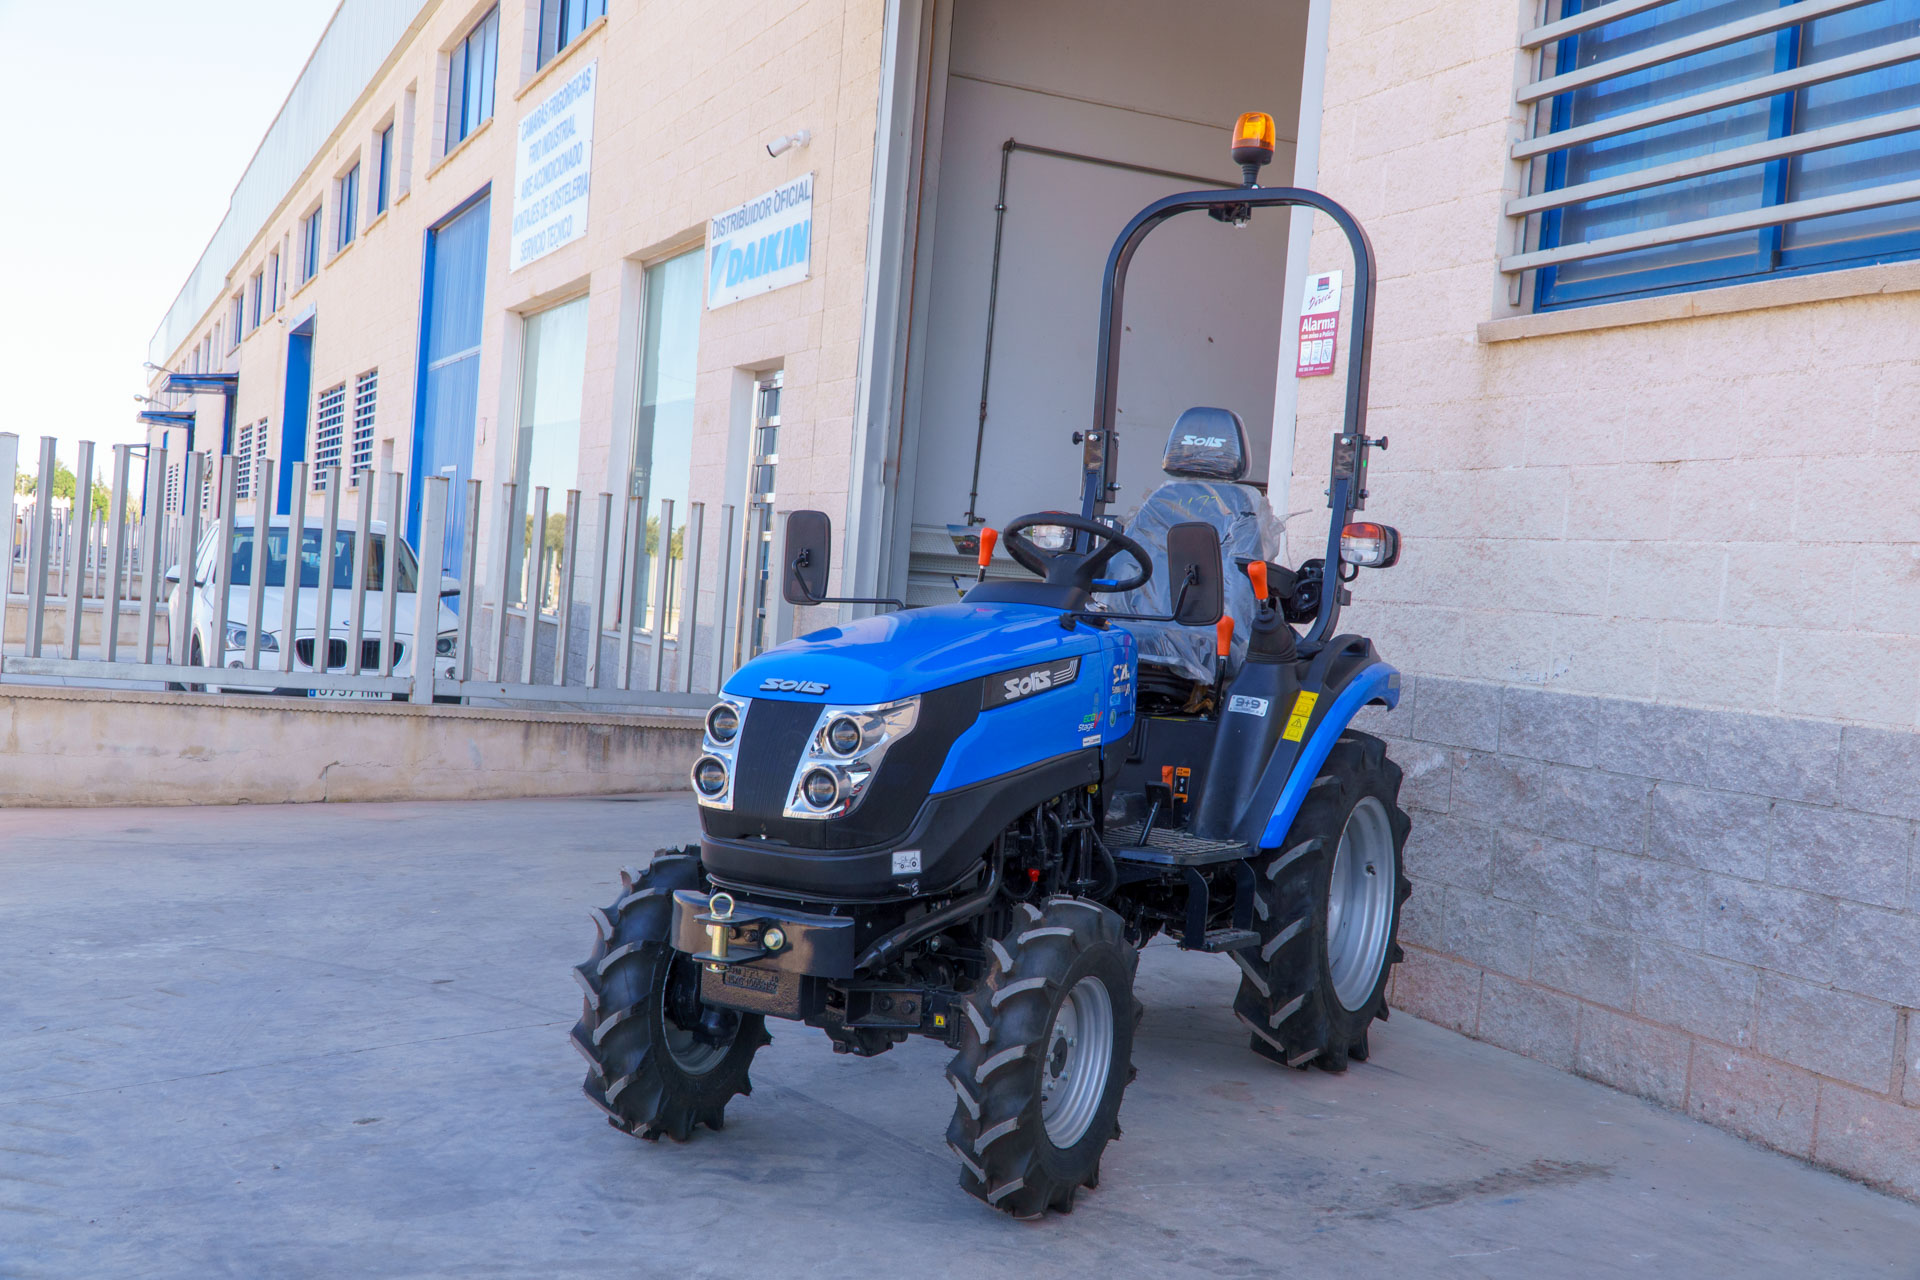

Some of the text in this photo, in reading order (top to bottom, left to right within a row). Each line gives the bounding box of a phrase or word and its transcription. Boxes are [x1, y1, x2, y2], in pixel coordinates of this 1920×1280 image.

[712, 179, 811, 240] DISTRIBUIDOR OFICIAL
[725, 219, 809, 288] DAIKIN
[1301, 317, 1336, 333] Alarma
[1235, 697, 1261, 709] 9+9
